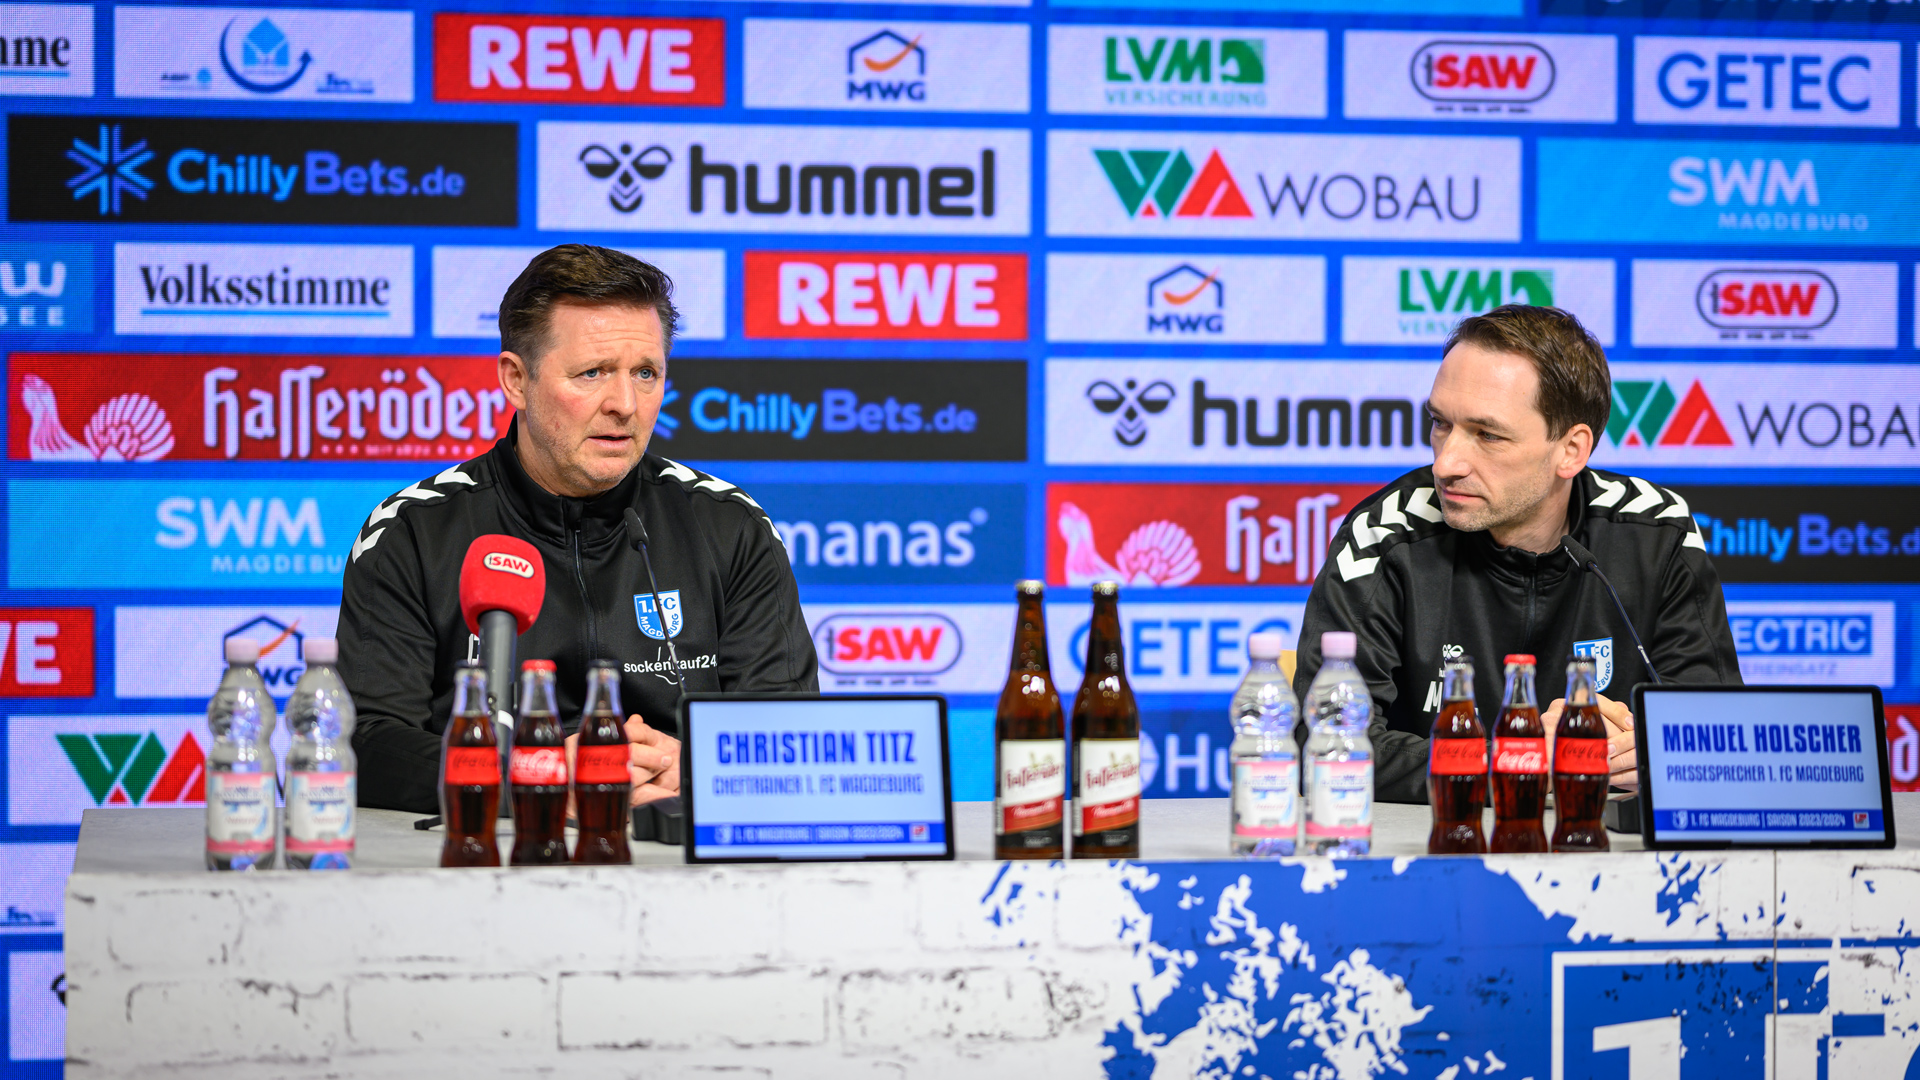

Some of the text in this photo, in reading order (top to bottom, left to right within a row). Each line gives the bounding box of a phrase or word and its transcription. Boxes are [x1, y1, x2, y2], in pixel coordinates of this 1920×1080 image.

[469, 25, 695, 92] REWE
[1105, 37, 1212, 83] LVM
[848, 81, 926, 101] MWG
[1658, 52, 1871, 112] GETEC
[690, 145, 996, 218] hummel
[1257, 172, 1480, 221] WOBAU
[1668, 157, 1820, 206] SWM
[1718, 212, 1869, 232] MAGDEBURG
[140, 264, 391, 306] Volksstimme
[778, 262, 1000, 327] REWE
[1400, 269, 1502, 312] LVM
[1147, 314, 1224, 334] MWG
[1192, 379, 1434, 448] humm
[1738, 403, 1920, 447] WOBA
[155, 497, 325, 549] SWM
[640, 613, 679, 637] MAGDBURG
[717, 731, 917, 765] CHRISTIAN TITZ
[1662, 724, 1862, 753] MANUEL HOLSCHER
[713, 775, 801, 795] CHEFTRAINER
[840, 774, 924, 795] MAGDEBURG
[1667, 765, 1865, 783] PRESSESPRECHER 1. FC MAGDEBURG
